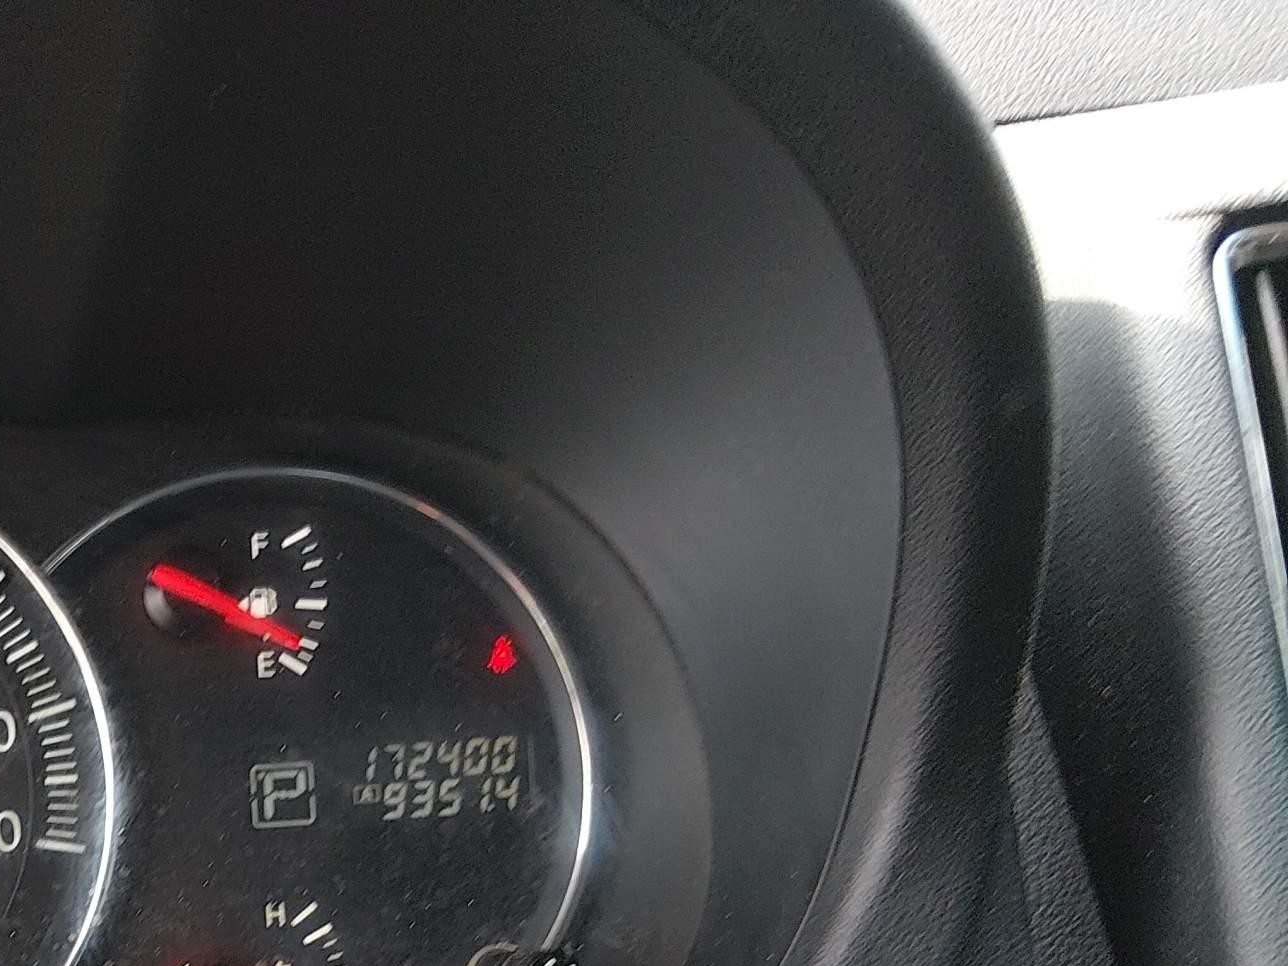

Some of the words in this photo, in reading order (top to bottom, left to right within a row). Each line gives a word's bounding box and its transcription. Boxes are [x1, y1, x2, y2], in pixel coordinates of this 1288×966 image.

[250, 531, 269, 559] F
[257, 650, 276, 679] E
[365, 735, 518, 782] 172400
[263, 769, 305, 820] P
[265, 901, 286, 927] H
